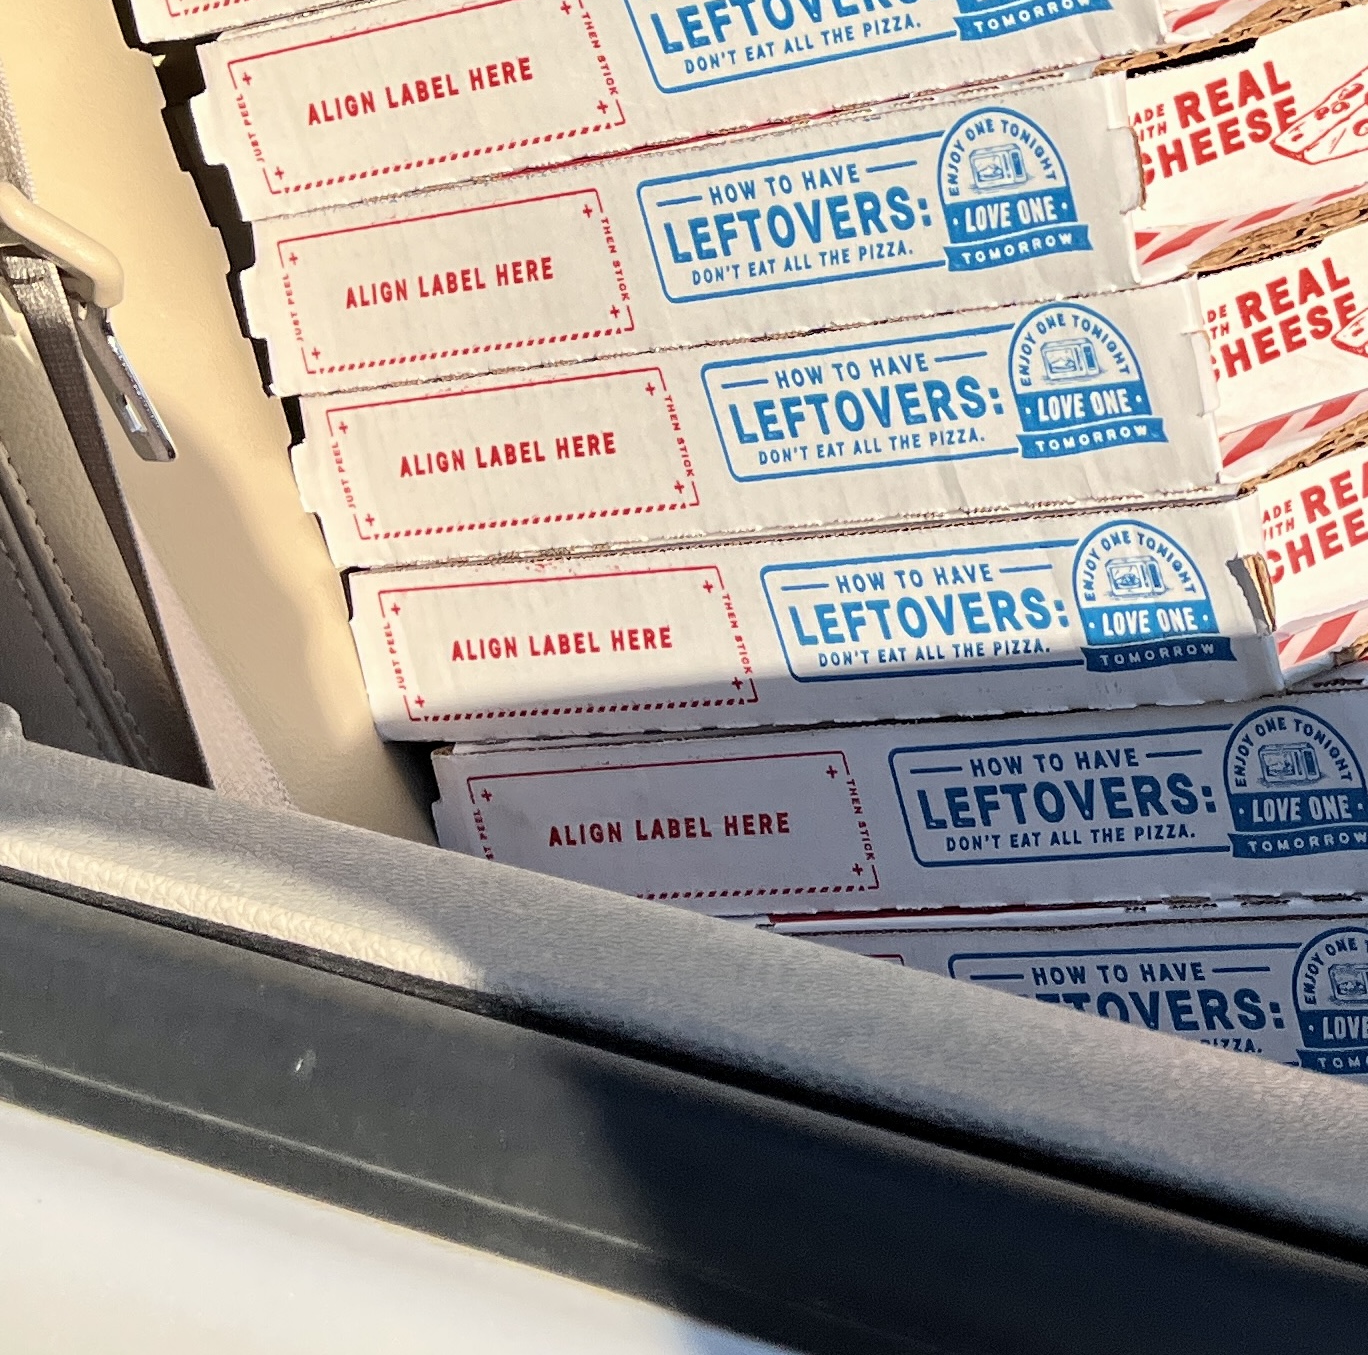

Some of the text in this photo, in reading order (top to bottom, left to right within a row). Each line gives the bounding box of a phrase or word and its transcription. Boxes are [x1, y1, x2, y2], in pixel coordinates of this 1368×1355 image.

[308, 58, 533, 125] ALIGN LABEL HERE
[1175, 61, 1291, 128] REAL
[665, 186, 932, 264] LEFTOVERS:
[965, 195, 1058, 232] LOVE ONE
[347, 258, 553, 308] ALIGN LABEL HERE
[1236, 258, 1350, 328] REAL
[1211, 291, 1357, 383] HEESE
[730, 375, 1003, 444] LEFTOVERS:
[1037, 389, 1131, 421] LOVE ONE
[401, 433, 616, 477] ALIGN LABEL HERE
[790, 588, 1069, 646] LEFTOVERS:
[1102, 607, 1198, 635] LOVE ONE
[453, 628, 672, 660] ALIGN LABEL HERE
[918, 773, 1215, 828] LEFTOVERS:
[1252, 794, 1351, 822] LOVE ONE
[550, 814, 790, 846] ALIGN LABEL HERE
[1033, 964, 1205, 984] HOW TO HAVE
[1036, 988, 1284, 1033] OVERS:
